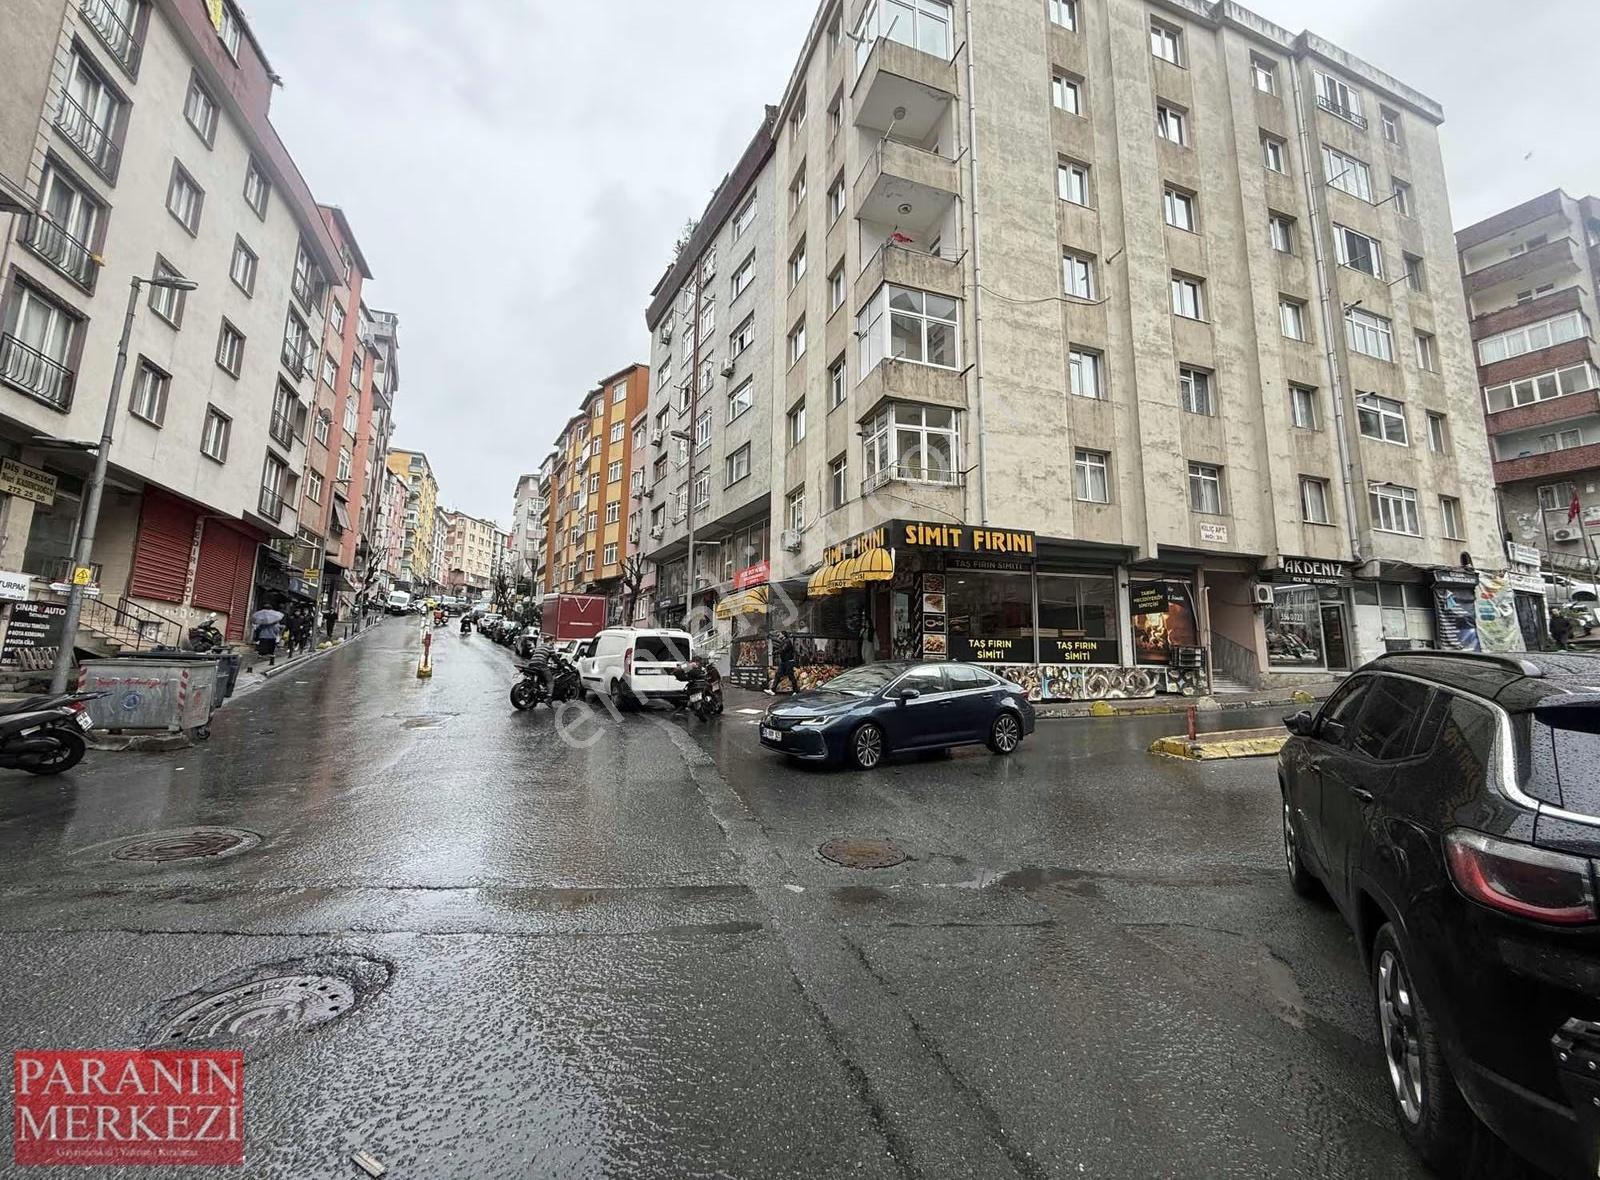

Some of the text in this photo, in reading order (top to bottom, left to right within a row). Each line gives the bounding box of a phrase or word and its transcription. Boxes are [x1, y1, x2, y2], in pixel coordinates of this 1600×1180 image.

[905, 523, 1033, 553] SİMİT FIRINI
[44, 607, 67, 616] AUTO
[968, 639, 1012, 649] TAŞ FIRIN
[1056, 641, 1097, 650] TAŞ FIRIN
[977, 649, 1004, 659] SİMİTİ
[1064, 650, 1090, 661] SİMİTİ
